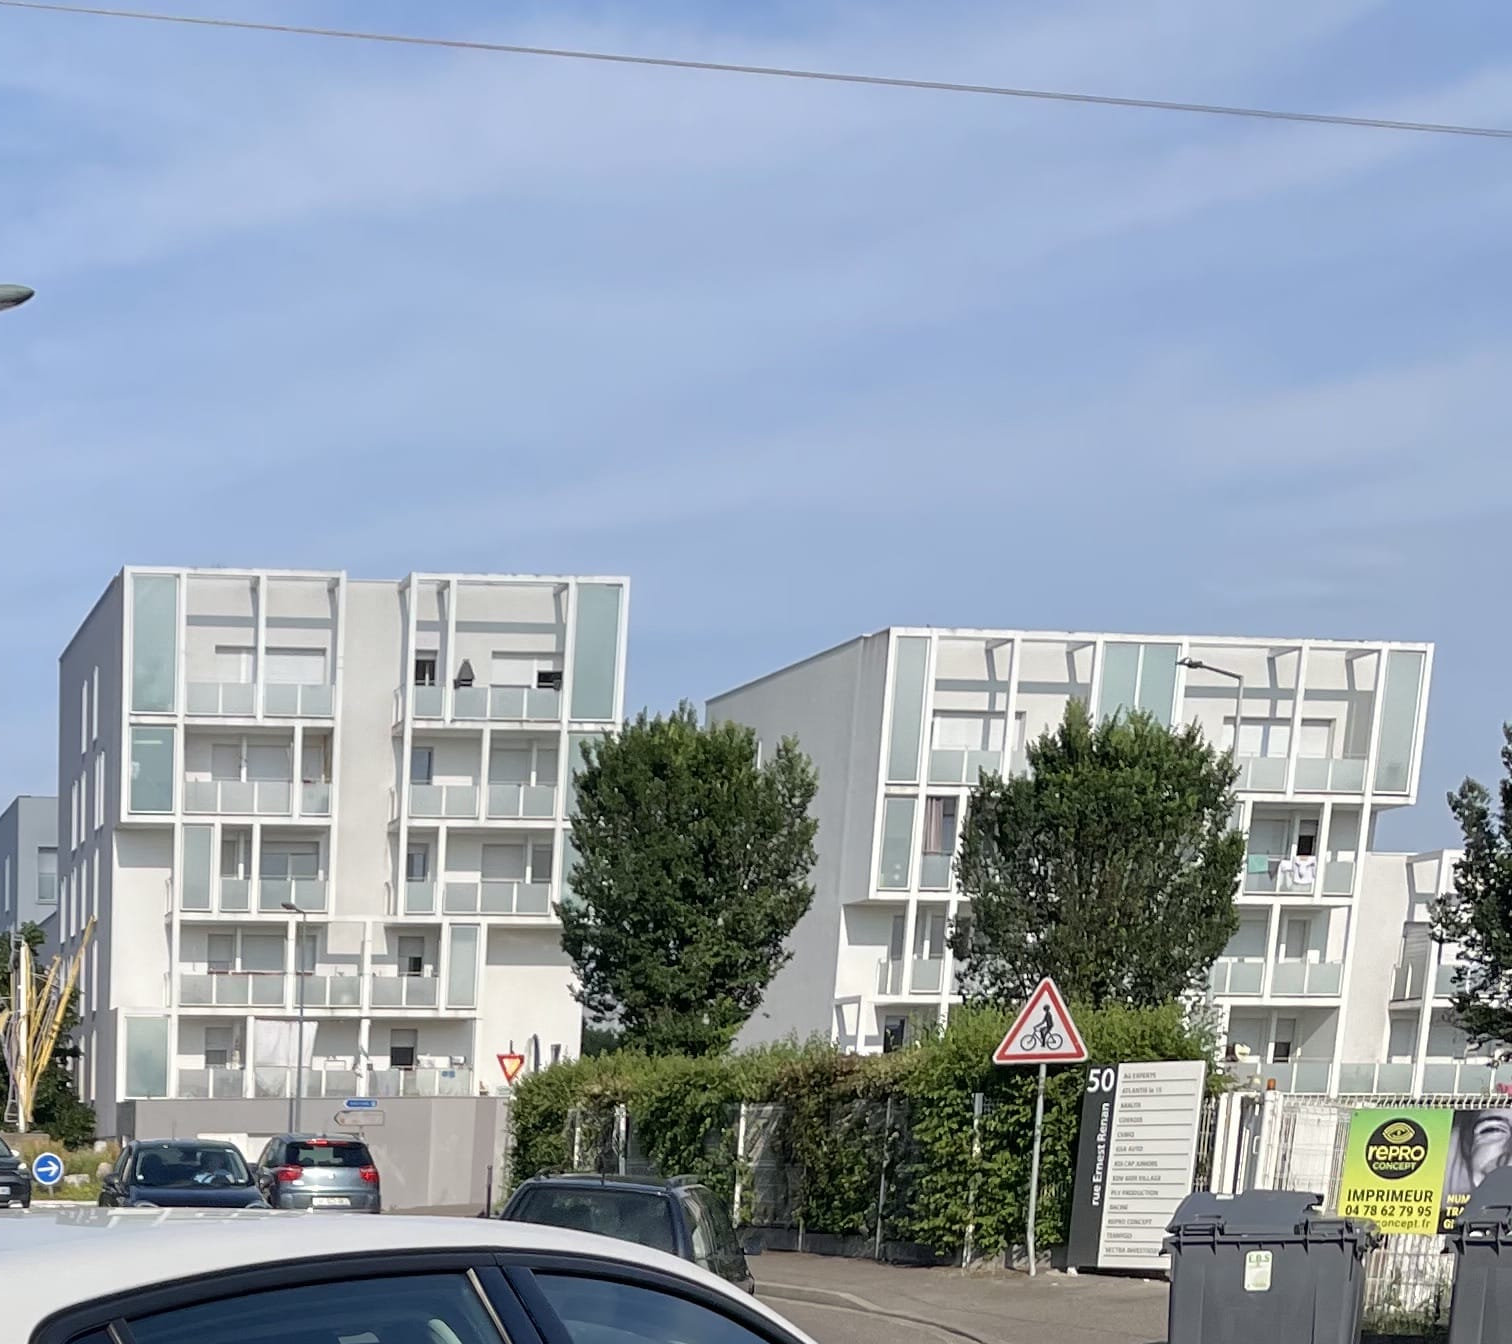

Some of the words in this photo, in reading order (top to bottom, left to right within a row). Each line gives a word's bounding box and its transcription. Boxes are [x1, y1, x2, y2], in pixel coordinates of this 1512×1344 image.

[1086, 1068, 1115, 1093] 50
[1096, 1102, 1110, 1142] Renan
[1092, 1143, 1106, 1182] Ernest
[1372, 1161, 1417, 1171] CONCEPT
[1092, 1184, 1102, 1206] rue
[1347, 1189, 1434, 1203] IMPRIMEUR
[1345, 1204, 1359, 1216] 04
[1363, 1205, 1377, 1216] 78
[1381, 1205, 1395, 1217] 62
[1399, 1205, 1413, 1217] 79
[1417, 1206, 1432, 1217] 95
